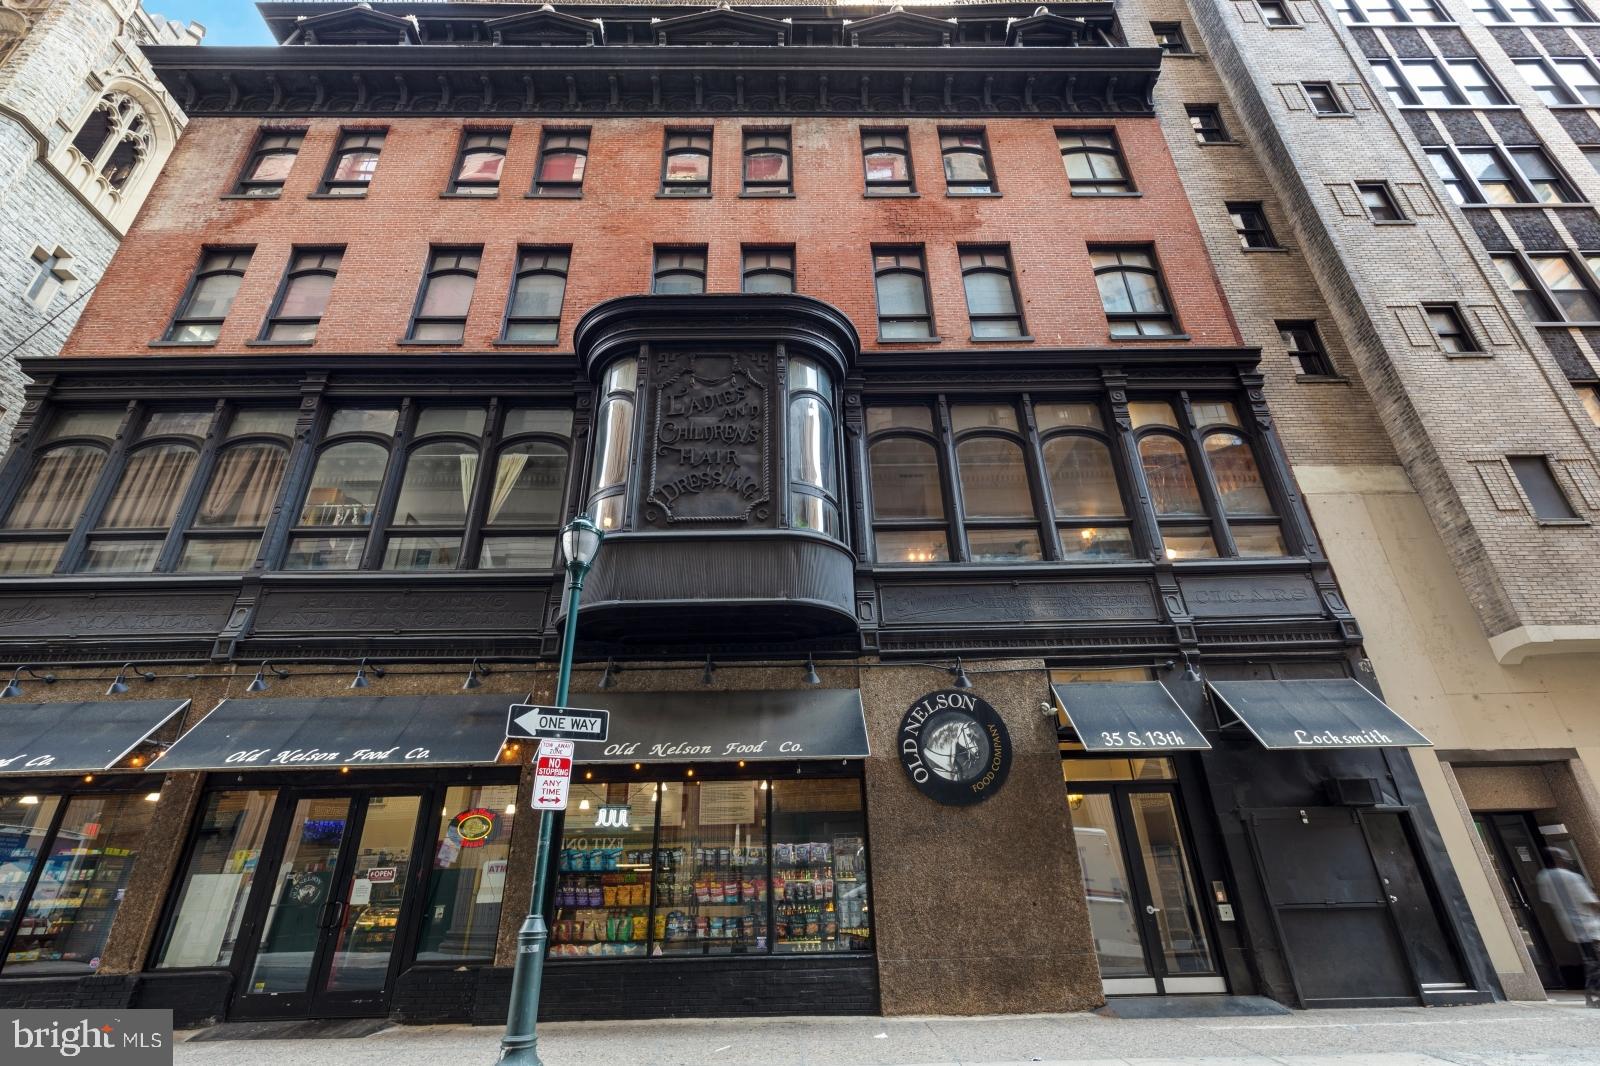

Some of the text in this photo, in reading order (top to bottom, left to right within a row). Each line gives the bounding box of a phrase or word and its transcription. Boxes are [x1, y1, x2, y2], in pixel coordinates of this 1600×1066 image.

[657, 446, 741, 467] HAIR
[655, 468, 760, 508] DRESSING
[539, 716, 597, 731] ONE WAY
[903, 693, 977, 783] OLD NELSON
[1101, 731, 1123, 746] 35
[1294, 729, 1393, 745] Locksmith
[225, 746, 430, 764] Old Nelson Food Co.
[604, 740, 803, 757] Old Nelson Food Co.
[548, 758, 561, 768] NO
[972, 723, 1002, 793] FOOD COMPANY
[538, 767, 569, 777] STOPPING
[541, 788, 561, 796] TIME
[374, 870, 393, 878] OPEN
[488, 864, 507, 873] ATM
